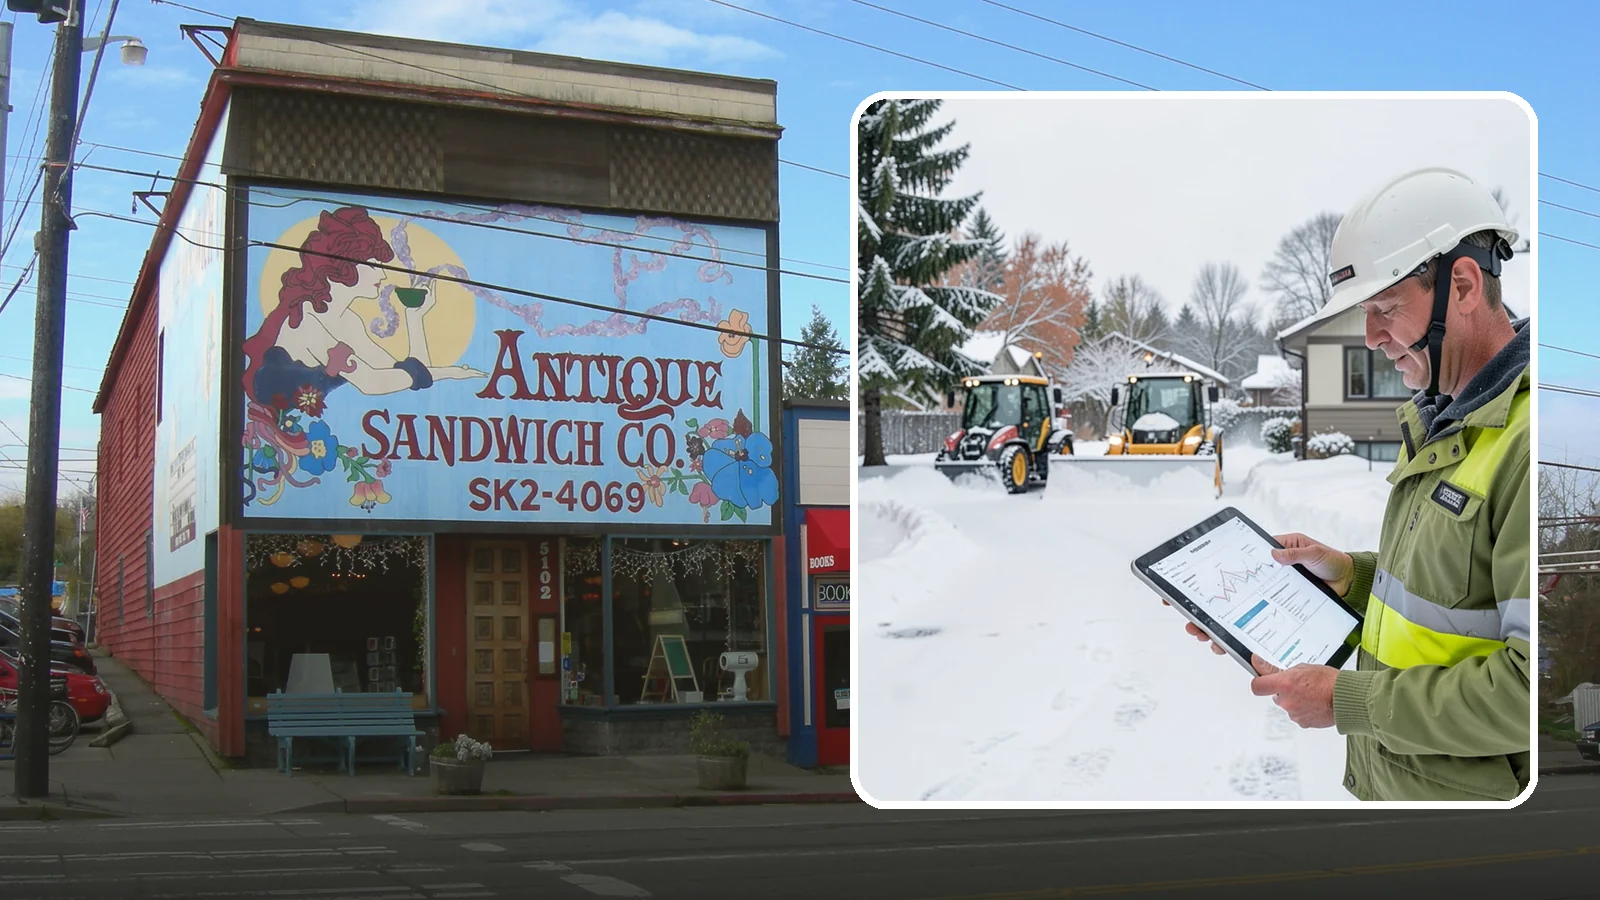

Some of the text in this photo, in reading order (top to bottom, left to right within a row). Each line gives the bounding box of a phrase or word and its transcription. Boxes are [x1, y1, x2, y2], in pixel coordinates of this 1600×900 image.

[476, 330, 724, 420] ANTIQUE
[361, 409, 686, 468] SANDWICH CO.
[468, 477, 646, 512] SK2-4069
[540, 541, 551, 600] 5102
[809, 555, 835, 569] BOOKS
